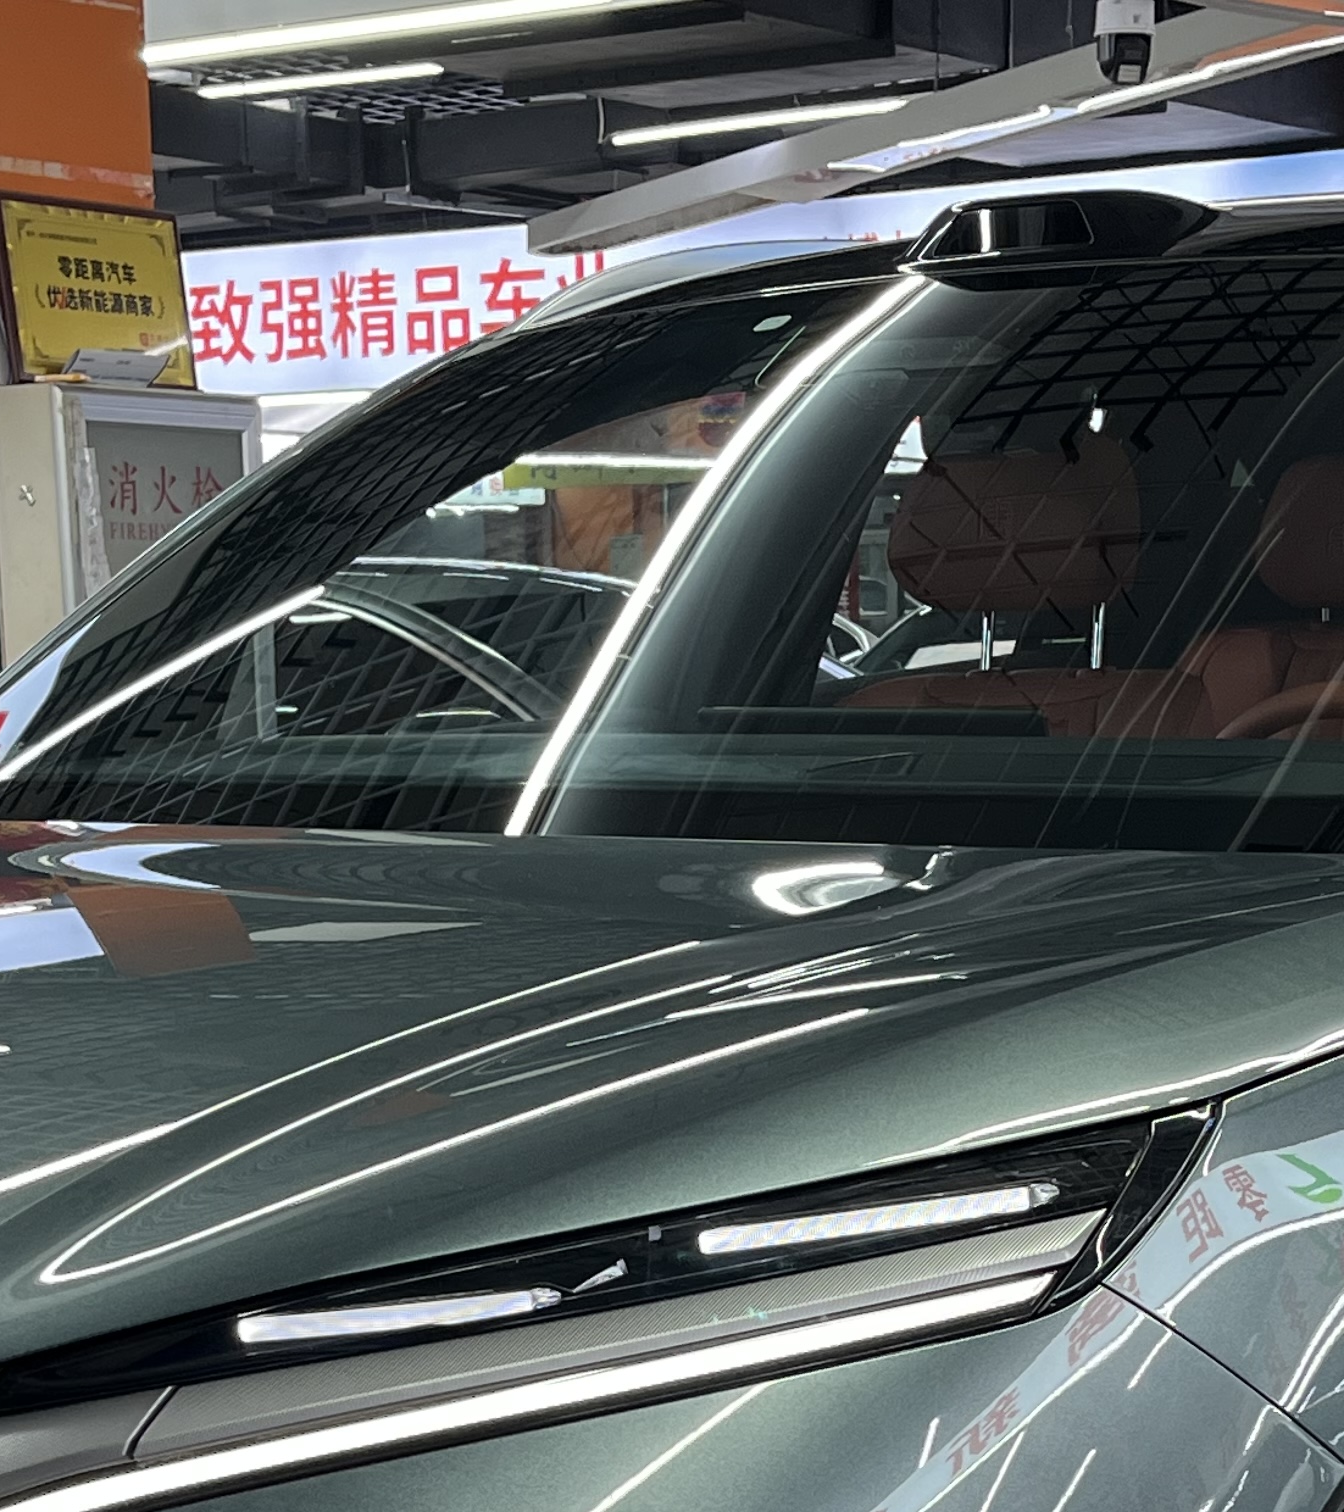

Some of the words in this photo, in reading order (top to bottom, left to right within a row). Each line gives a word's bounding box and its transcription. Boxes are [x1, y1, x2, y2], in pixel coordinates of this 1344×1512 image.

[57, 255, 137, 285] 零距离汽车
[108, 461, 226, 517] 消火栓
